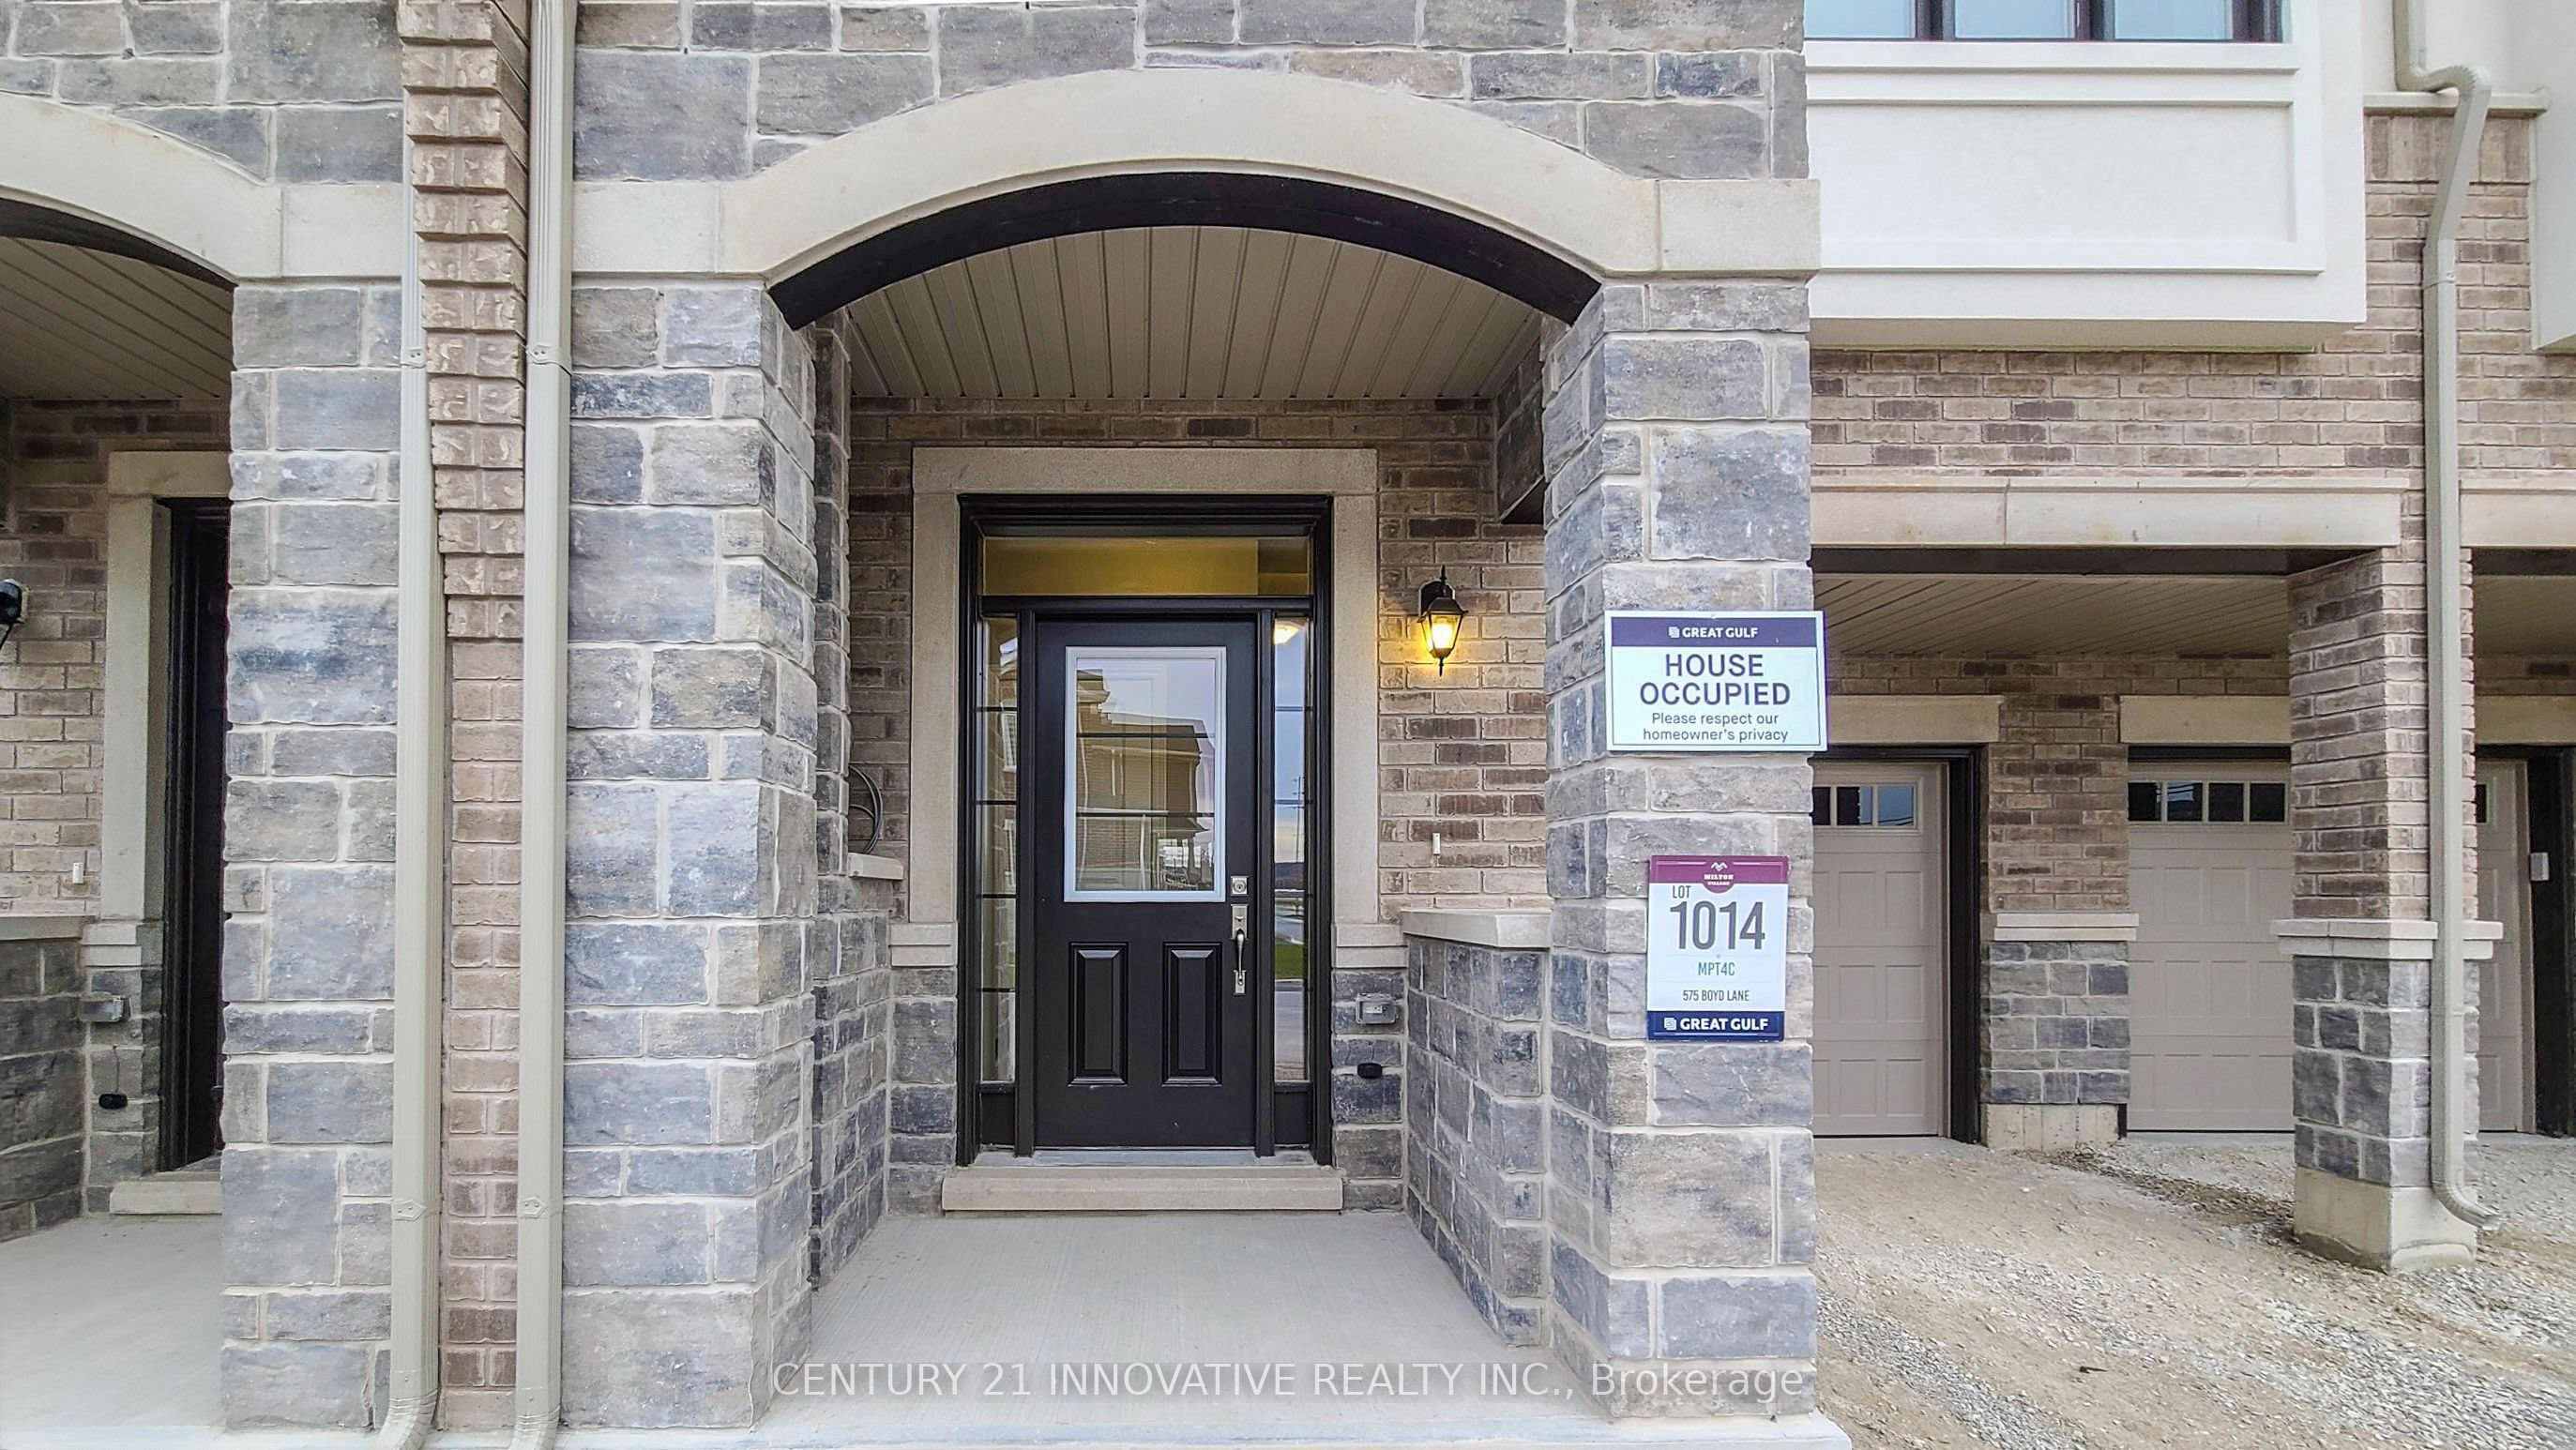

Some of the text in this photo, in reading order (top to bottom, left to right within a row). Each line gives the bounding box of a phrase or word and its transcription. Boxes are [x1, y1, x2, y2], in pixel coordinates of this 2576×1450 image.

[1682, 627, 1759, 639] GREAT GULF
[1665, 654, 1764, 677] HOUSE
[1640, 682, 1791, 705] OCCUPIED
[1652, 713, 1779, 728] Please respect our
[1643, 729, 1789, 744] homeowner's privacy
[1672, 885, 1691, 899] LOT
[1670, 900, 1765, 950] 1014
[1698, 962, 1735, 976] MPT4C
[1683, 990, 1750, 1002] 575 BOYD LANE
[1680, 1019, 1769, 1031] GREAT GULF
